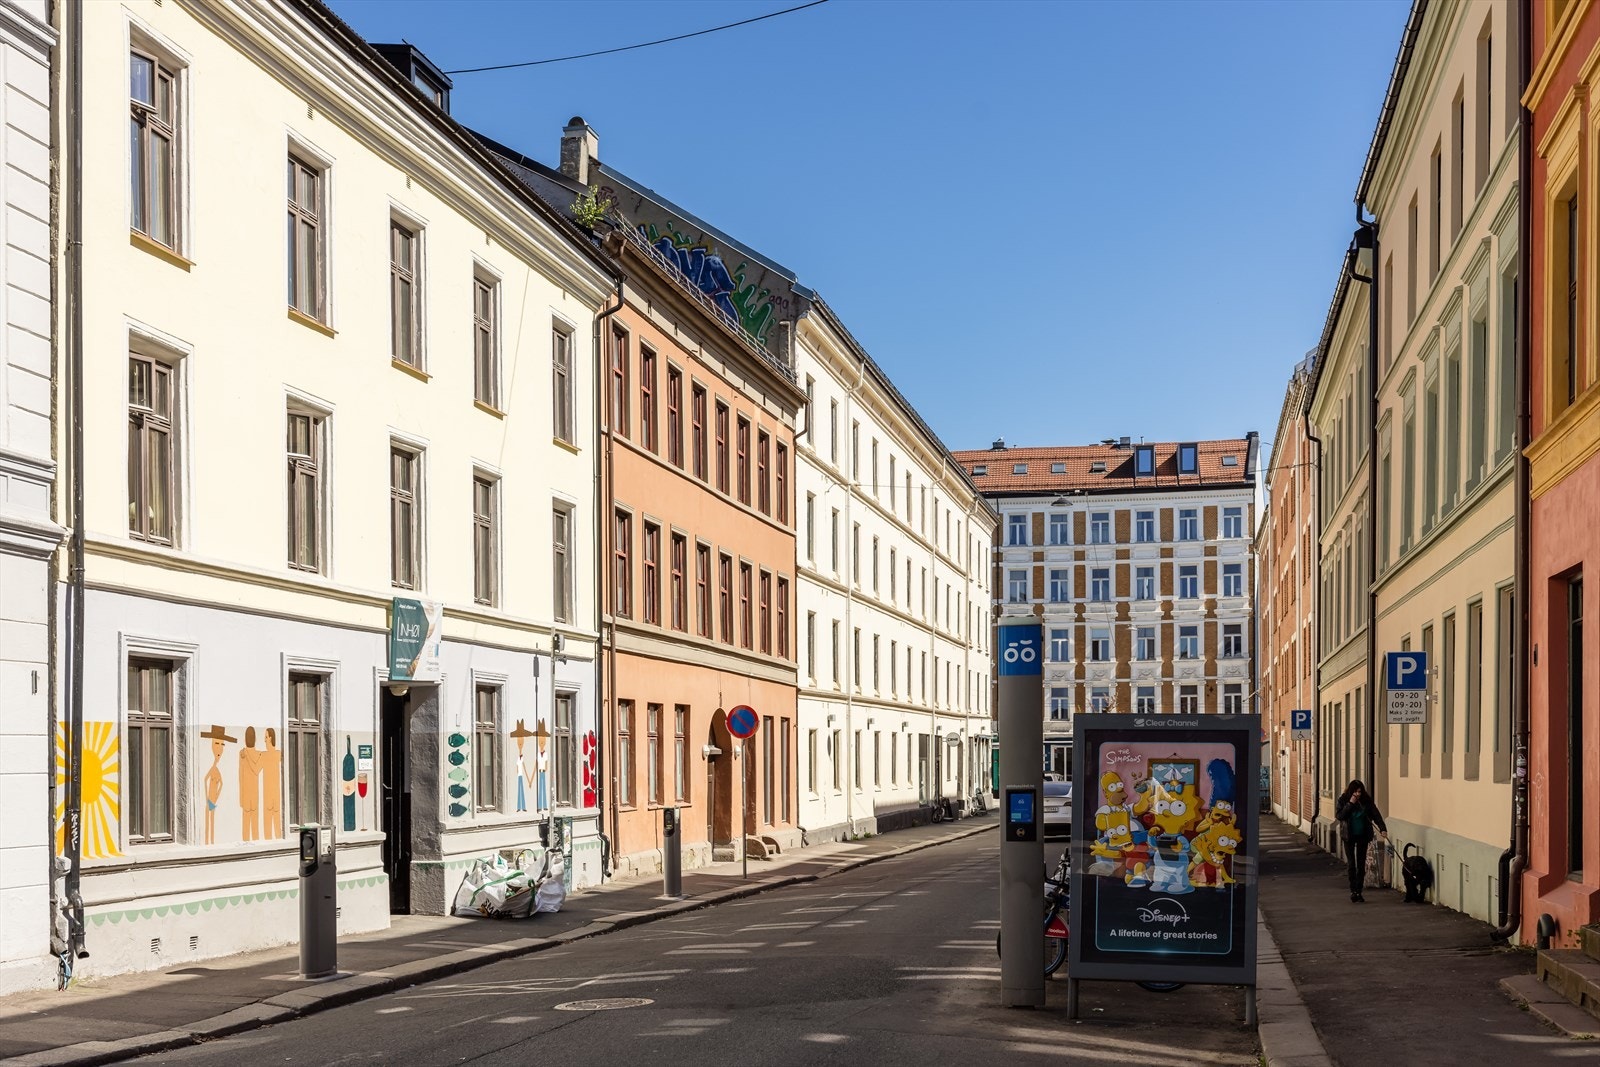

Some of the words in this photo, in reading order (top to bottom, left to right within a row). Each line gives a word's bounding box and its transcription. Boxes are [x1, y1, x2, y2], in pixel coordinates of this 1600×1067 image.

[1397, 656, 1417, 685] P
[1145, 719, 1165, 727] Clear
[1167, 719, 1199, 727] Channel
[1296, 712, 1307, 728] P
[1110, 929, 1117, 937] A
[1118, 929, 1151, 938] lifetime
[1152, 930, 1162, 938] of
[1163, 931, 1186, 940] great
[1187, 931, 1218, 940] stories
